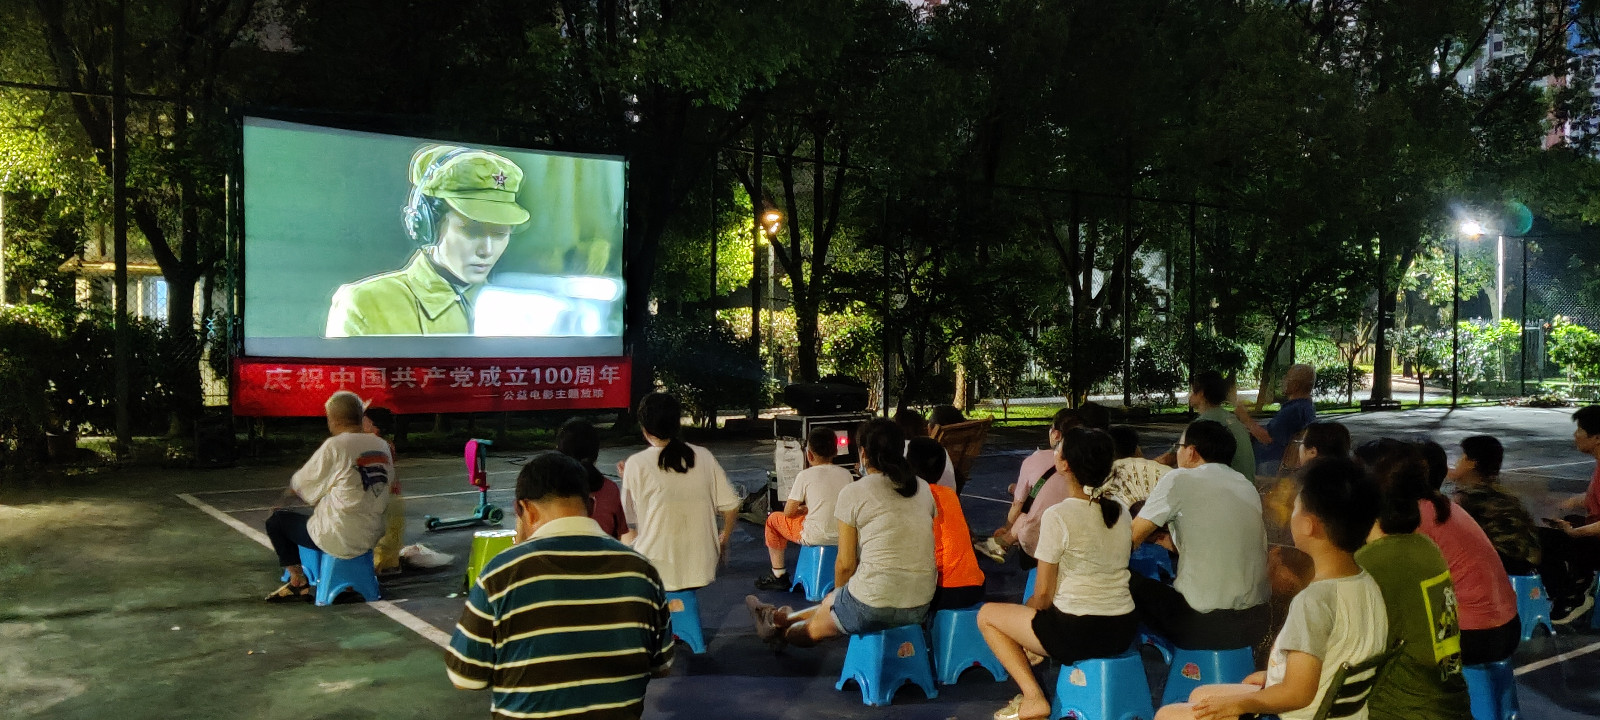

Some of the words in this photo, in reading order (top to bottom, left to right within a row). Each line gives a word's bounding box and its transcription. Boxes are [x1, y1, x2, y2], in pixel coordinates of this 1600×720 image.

[264, 365, 621, 390] 庆祝中国共产党成立100周年
